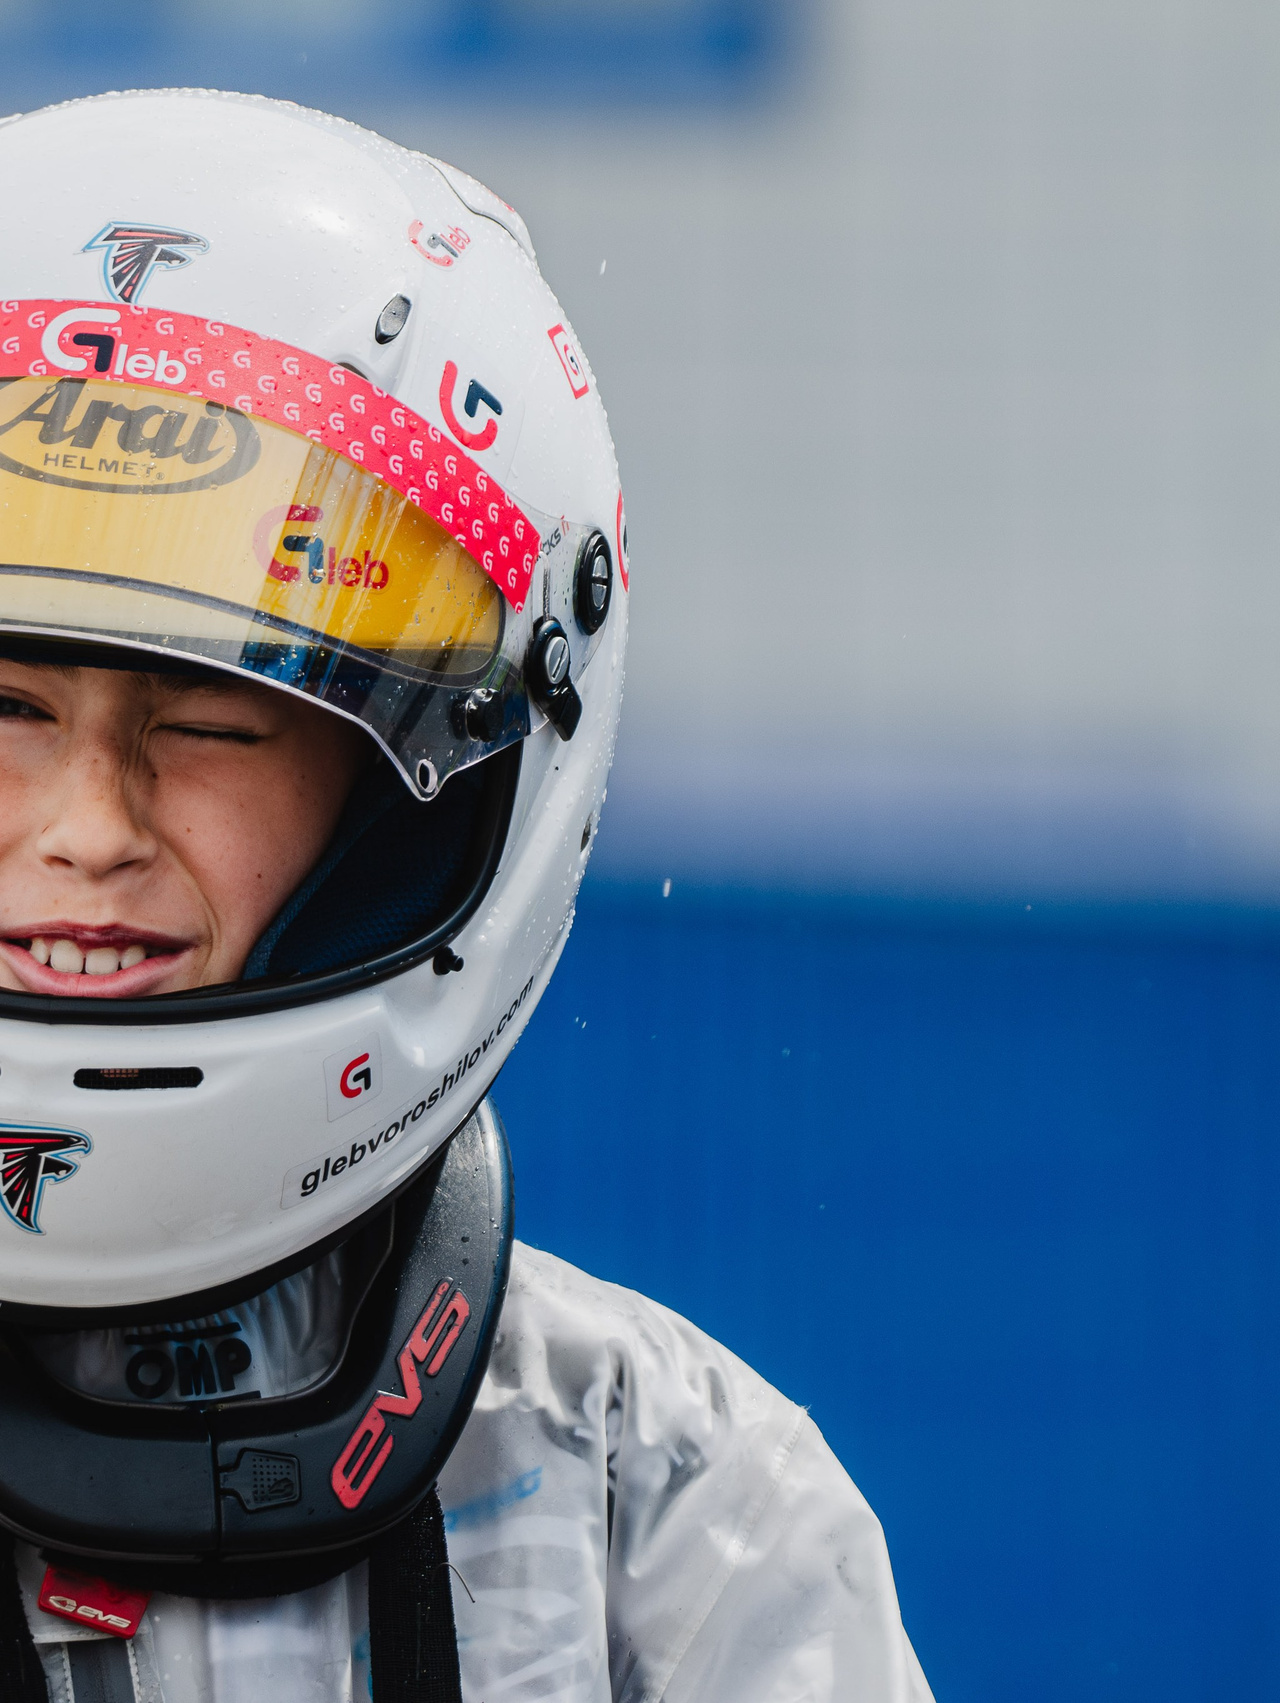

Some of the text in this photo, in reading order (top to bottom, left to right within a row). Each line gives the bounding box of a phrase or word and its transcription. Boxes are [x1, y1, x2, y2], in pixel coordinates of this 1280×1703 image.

[41, 308, 187, 385] Gleb
[43, 453, 158, 478] HELMET
[252, 504, 389, 590] Gleb
[300, 975, 535, 1198] glebvoroshilov.com
[125, 1337, 252, 1398] OMP
